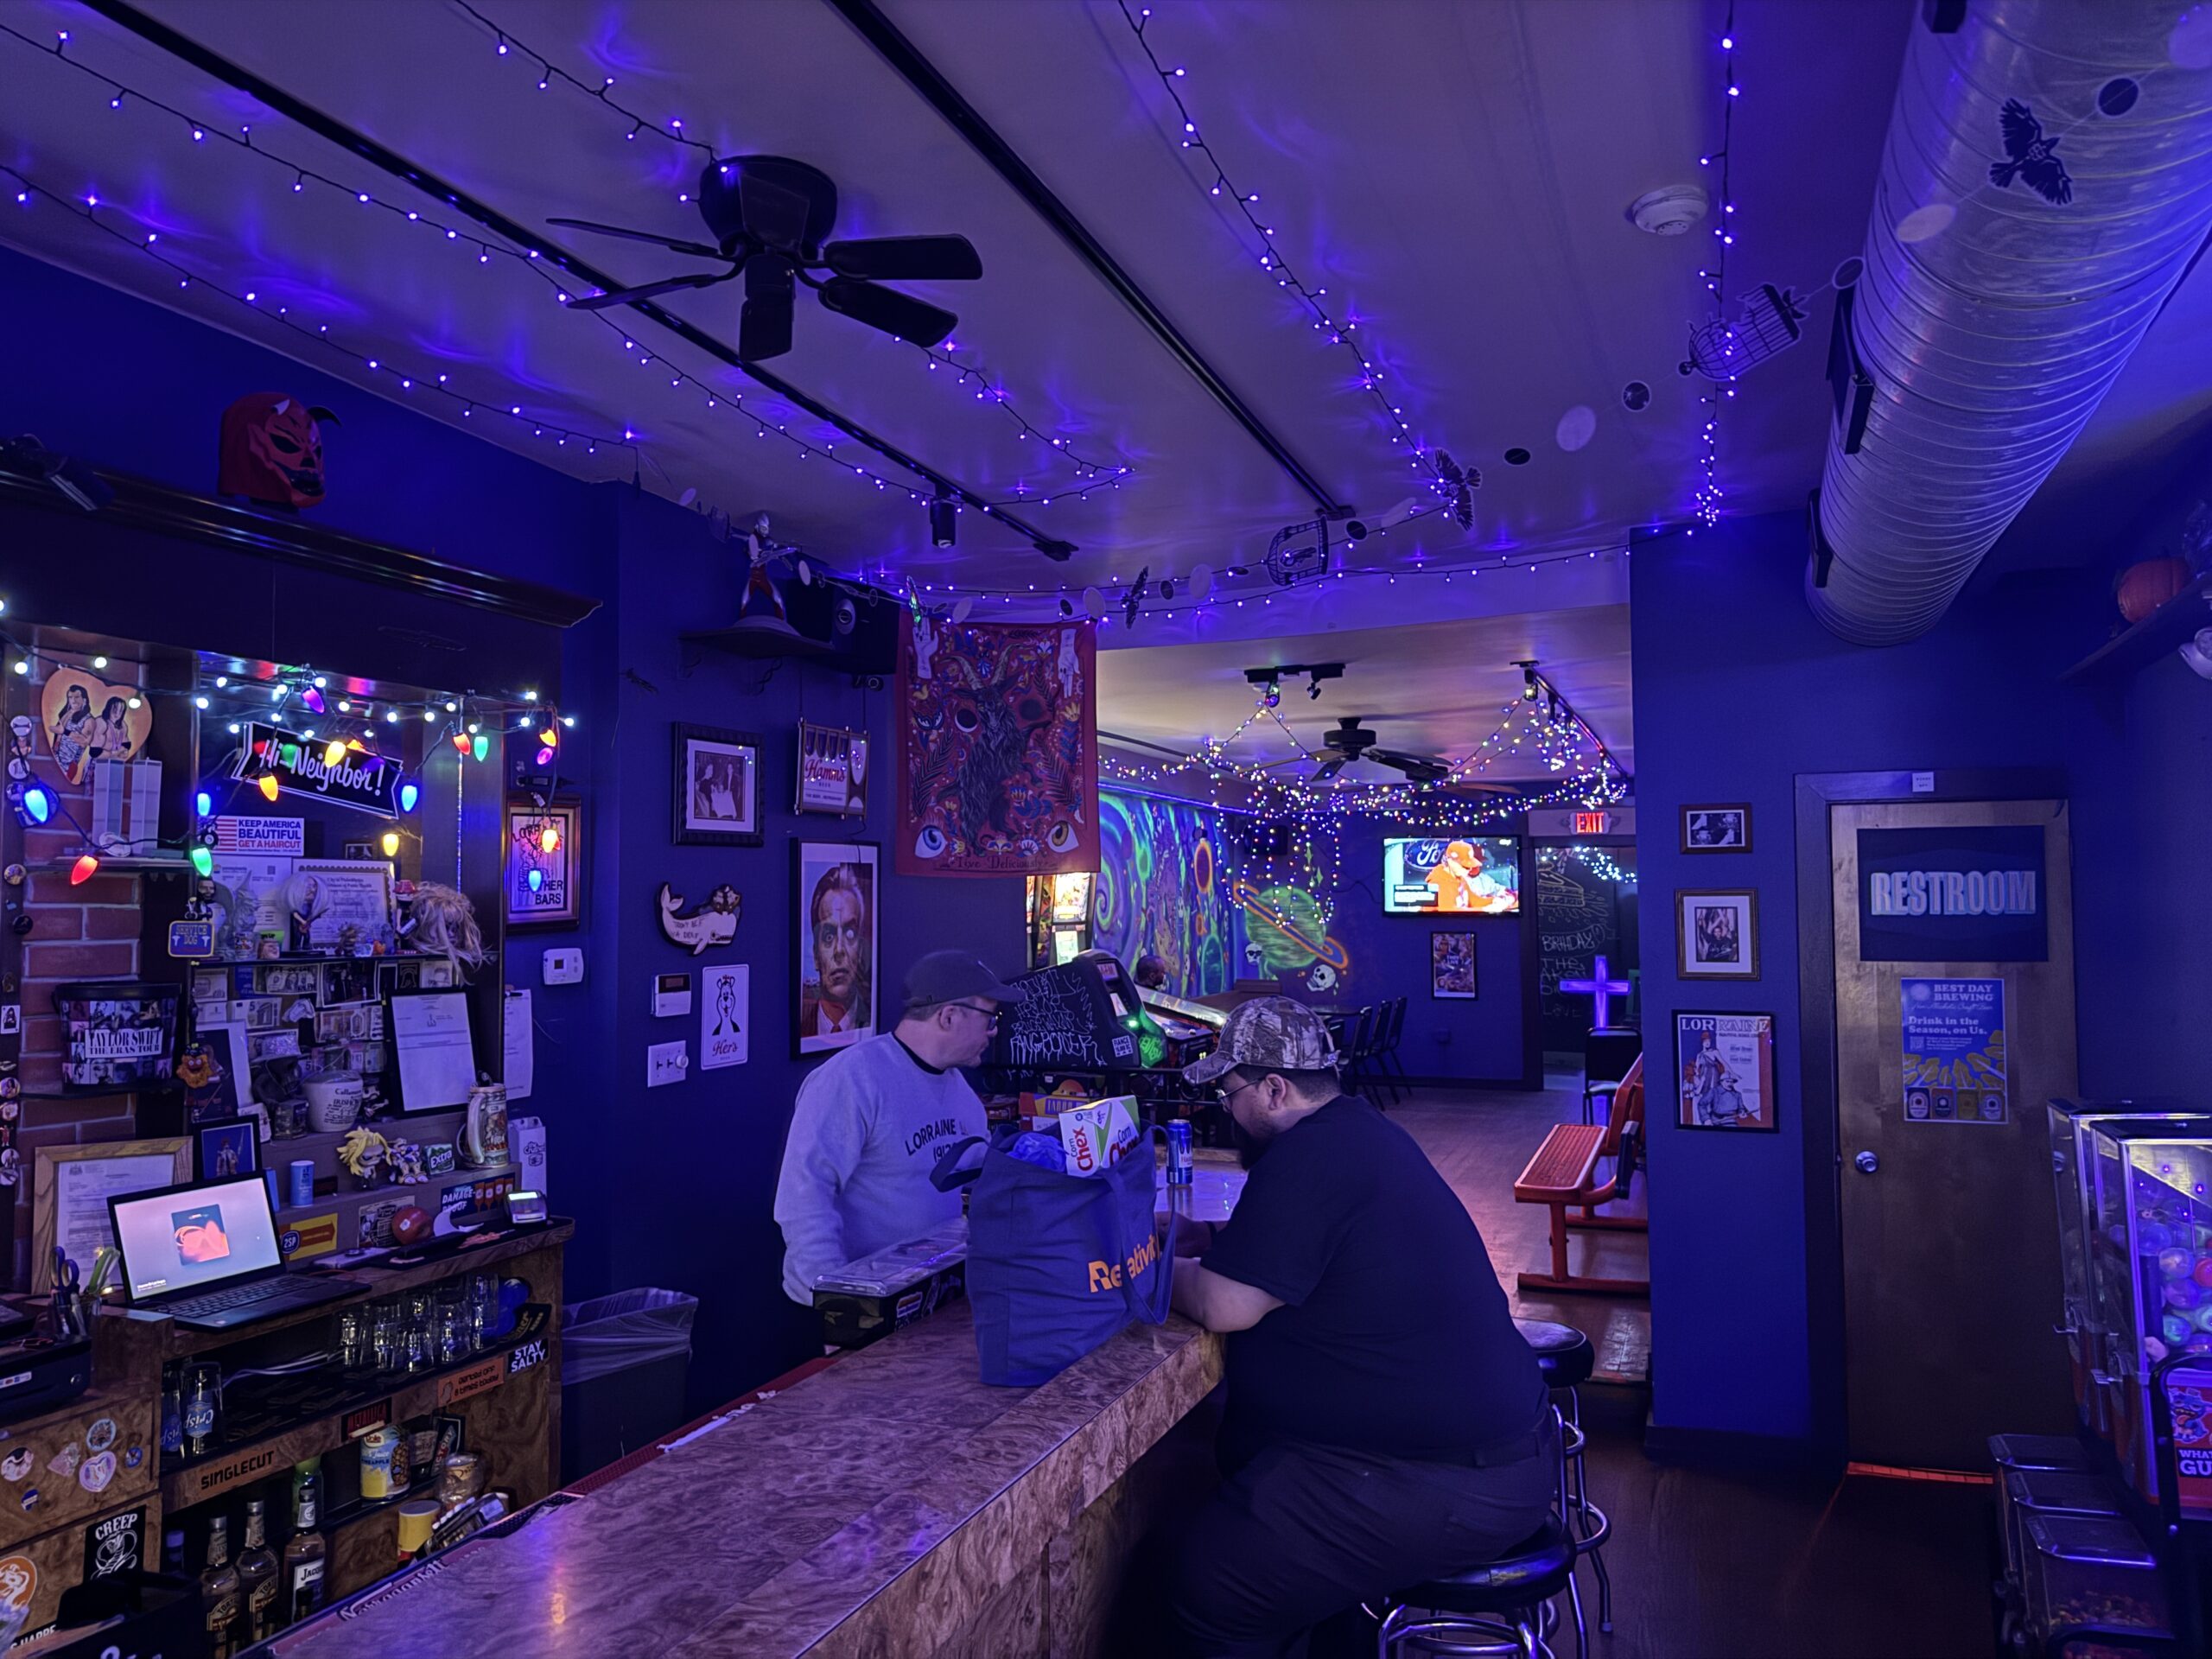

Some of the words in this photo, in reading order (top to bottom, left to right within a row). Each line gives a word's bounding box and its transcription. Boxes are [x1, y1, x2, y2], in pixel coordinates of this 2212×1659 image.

[238, 819, 262, 828] KEEP
[262, 821, 302, 830] AMERICA
[1575, 812, 1605, 833] EXIT
[238, 828, 302, 840] BEAUTIFUL
[535, 893, 562, 905] BARS
[1871, 870, 2037, 916] RESTROOM
[175, 925, 208, 935] SERVICE
[1933, 983, 1967, 993] BEST
[1967, 983, 1993, 993] DAY
[1933, 993, 1994, 1002] BREWING
[1681, 1018, 1769, 1032] LORRAINE
[1908, 1015, 1943, 1026] Drink
[1944, 1017, 1958, 1026] in
[1959, 1017, 1980, 1026] the
[1908, 1025, 1952, 1034] Season,
[1968, 1026, 1987, 1034] Us.
[88, 1031, 130, 1047] TAYLOR
[131, 1028, 161, 1046] SWIFT
[89, 1046, 105, 1055] THE
[109, 1046, 137, 1054] ERAS
[138, 1044, 160, 1052] TOUR
[905, 1117, 957, 1157] LORRAINE
[1117, 1126, 1132, 1144] Corn
[1069, 1138, 1078, 1158] Corn
[1072, 1125, 1094, 1172] Chex
[430, 1150, 453, 1169] Extra
[283, 1236, 297, 1249] 2SP
[514, 1339, 543, 1361] STAY
[511, 1348, 546, 1373] SALTY
[185, 1408, 214, 1429] Crisp
[200, 1450, 275, 1491] SINGLECUT
[94, 1513, 138, 1541] CREEP
